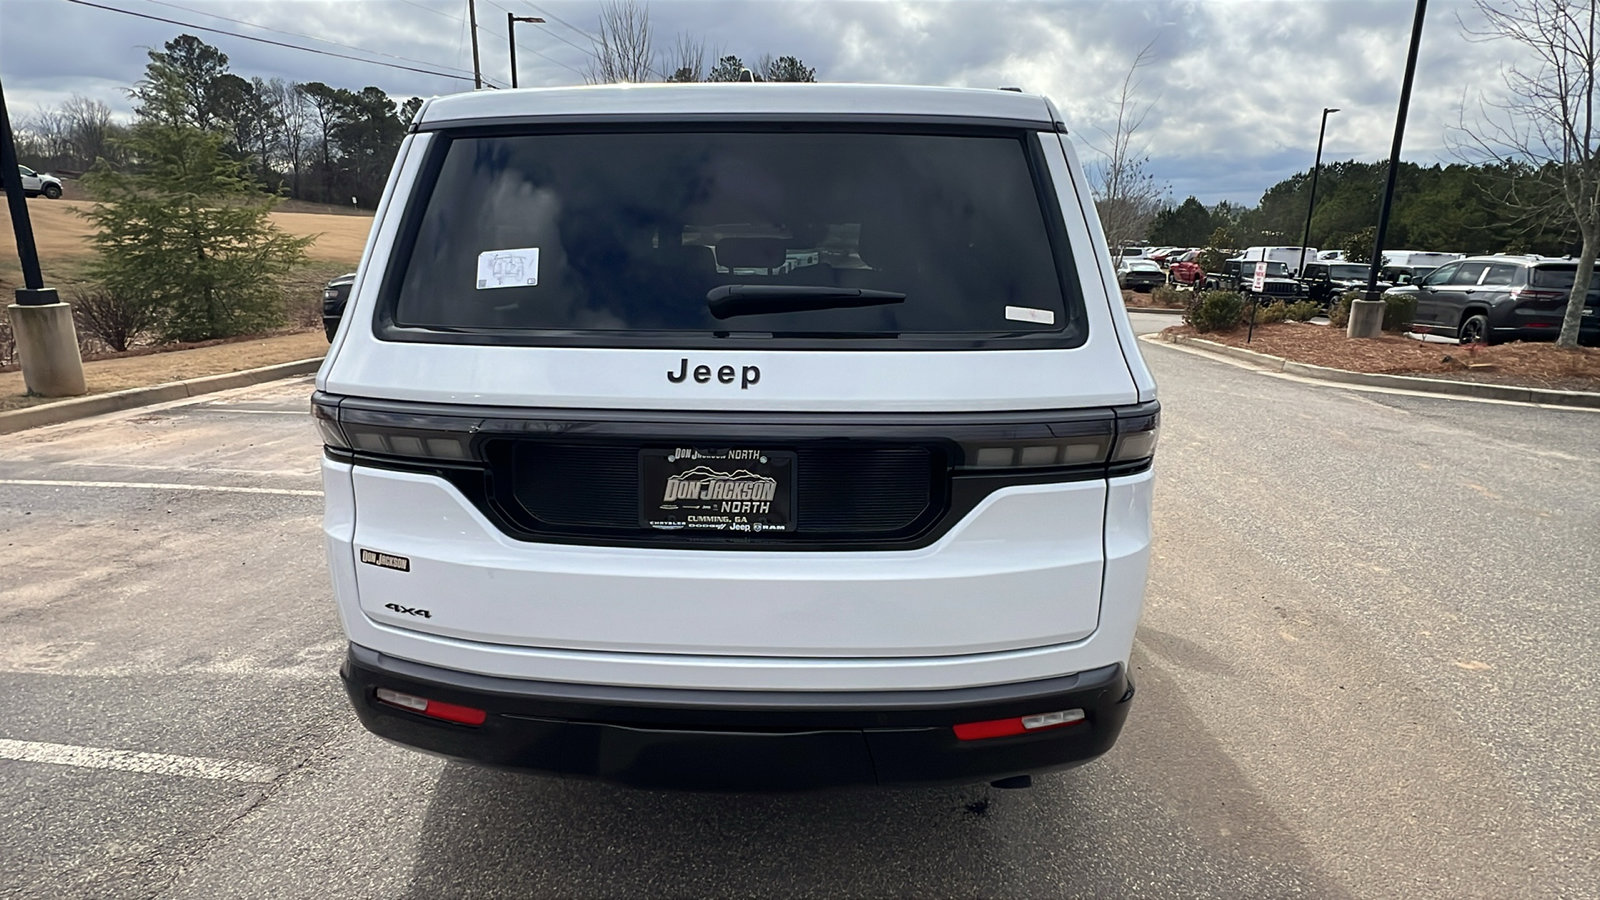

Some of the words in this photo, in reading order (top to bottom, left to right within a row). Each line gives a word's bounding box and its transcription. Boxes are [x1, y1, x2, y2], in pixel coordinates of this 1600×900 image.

[667, 358, 761, 390] Jeep
[727, 449, 760, 460] NORTH
[700, 480, 777, 501] JACKSON
[721, 501, 770, 514] NORTH
[376, 554, 407, 570] JACKSON
